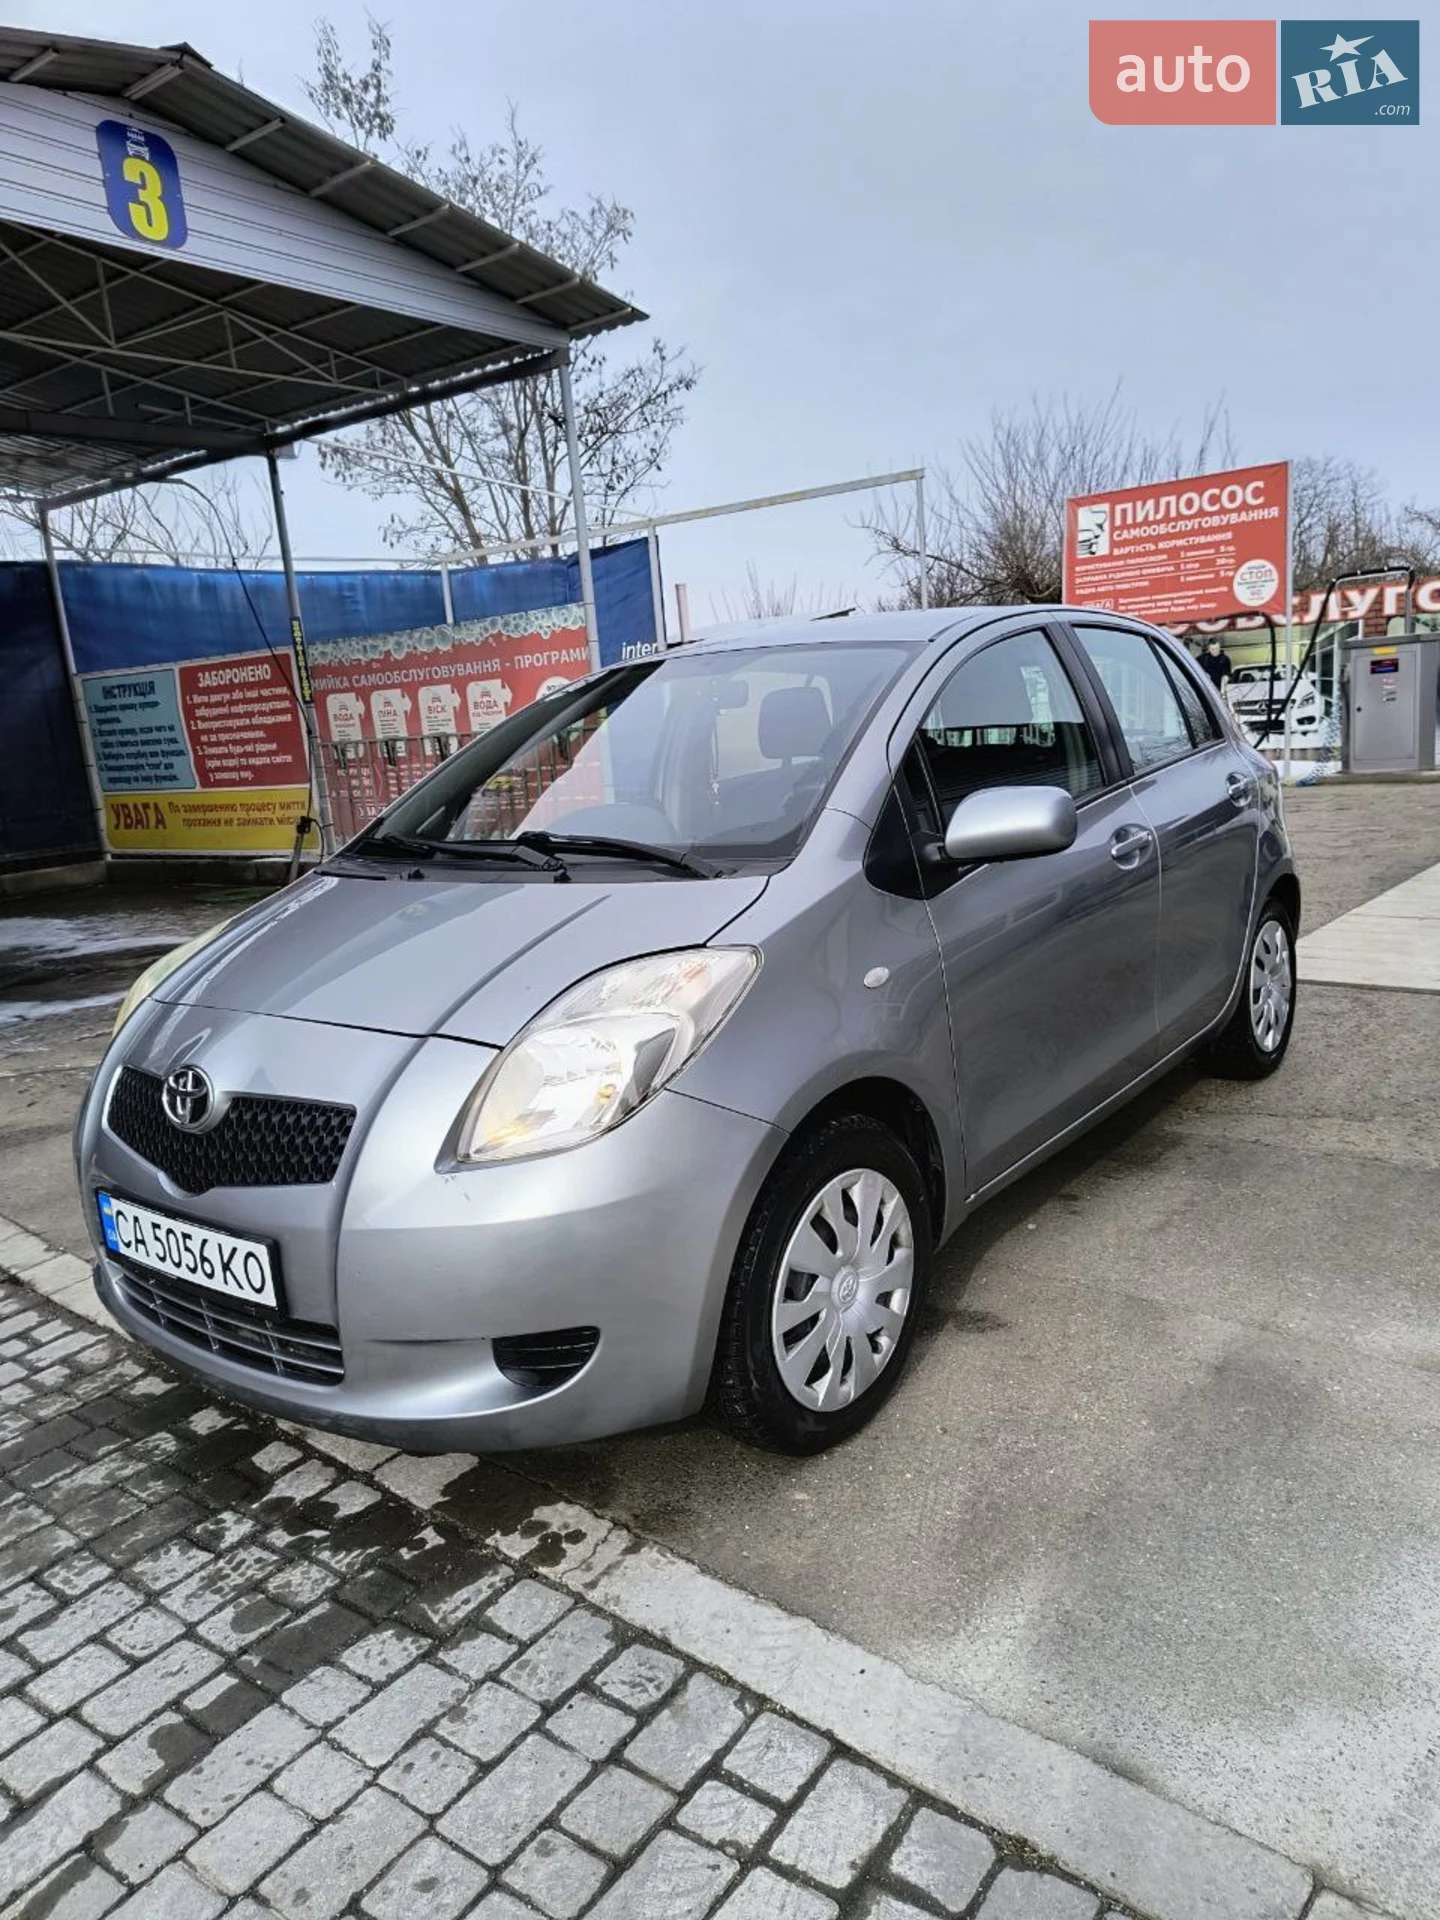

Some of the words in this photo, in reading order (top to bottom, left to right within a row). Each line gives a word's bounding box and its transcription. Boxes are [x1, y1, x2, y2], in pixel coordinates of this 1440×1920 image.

[122, 157, 169, 241] 3
[1114, 481, 1265, 527] ПИЛОСОС
[1113, 507, 1280, 541] САМООБСЛУГОВУВАННЯ
[1113, 542, 1156, 556] ВАРТІСТЬ
[1158, 532, 1233, 550] КОРИСТУВАННЯ
[1241, 569, 1272, 581] СТОП
[197, 664, 271, 688] ЗАБОРОНЕНО
[352, 660, 501, 687] САМООБСЛУГОВУВАННЯ
[102, 681, 156, 699] ІНСТРУКЦІЯ
[473, 701, 498, 711] ВОДА
[111, 802, 167, 830] УВАГА
[240, 802, 276, 815] процесу
